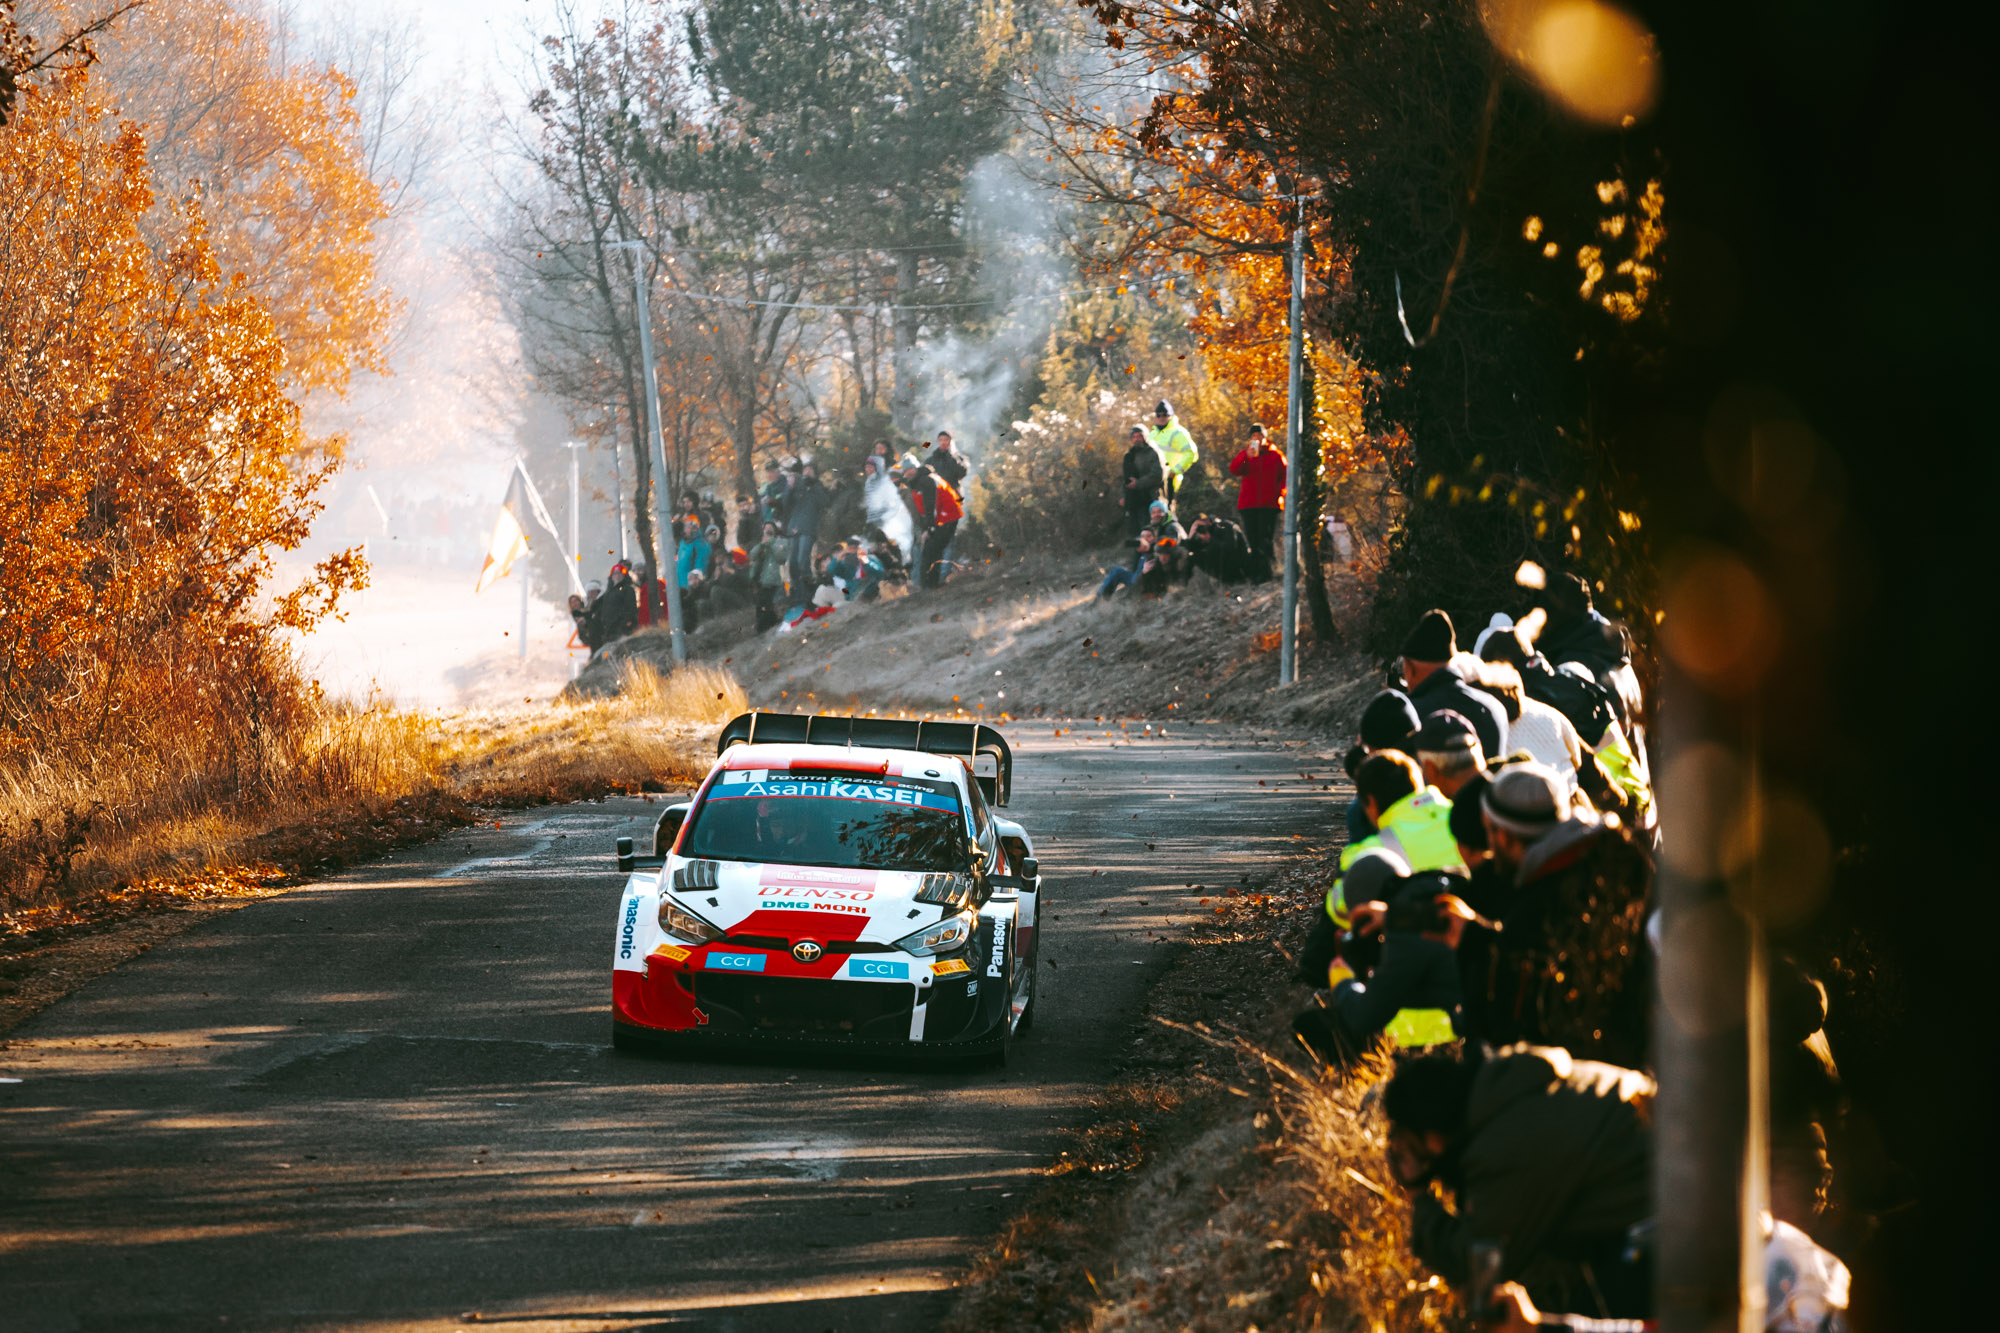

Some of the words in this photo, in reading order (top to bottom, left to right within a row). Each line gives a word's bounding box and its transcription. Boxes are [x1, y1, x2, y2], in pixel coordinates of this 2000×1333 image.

[740, 771, 750, 783] 1
[830, 776, 883, 785] GAZOO
[886, 781, 935, 793] Racing
[758, 887, 874, 901] DENSO
[762, 901, 809, 909] DMG
[814, 903, 867, 914] MORI
[620, 895, 645, 960] Panasonic
[986, 917, 1006, 978] Panason
